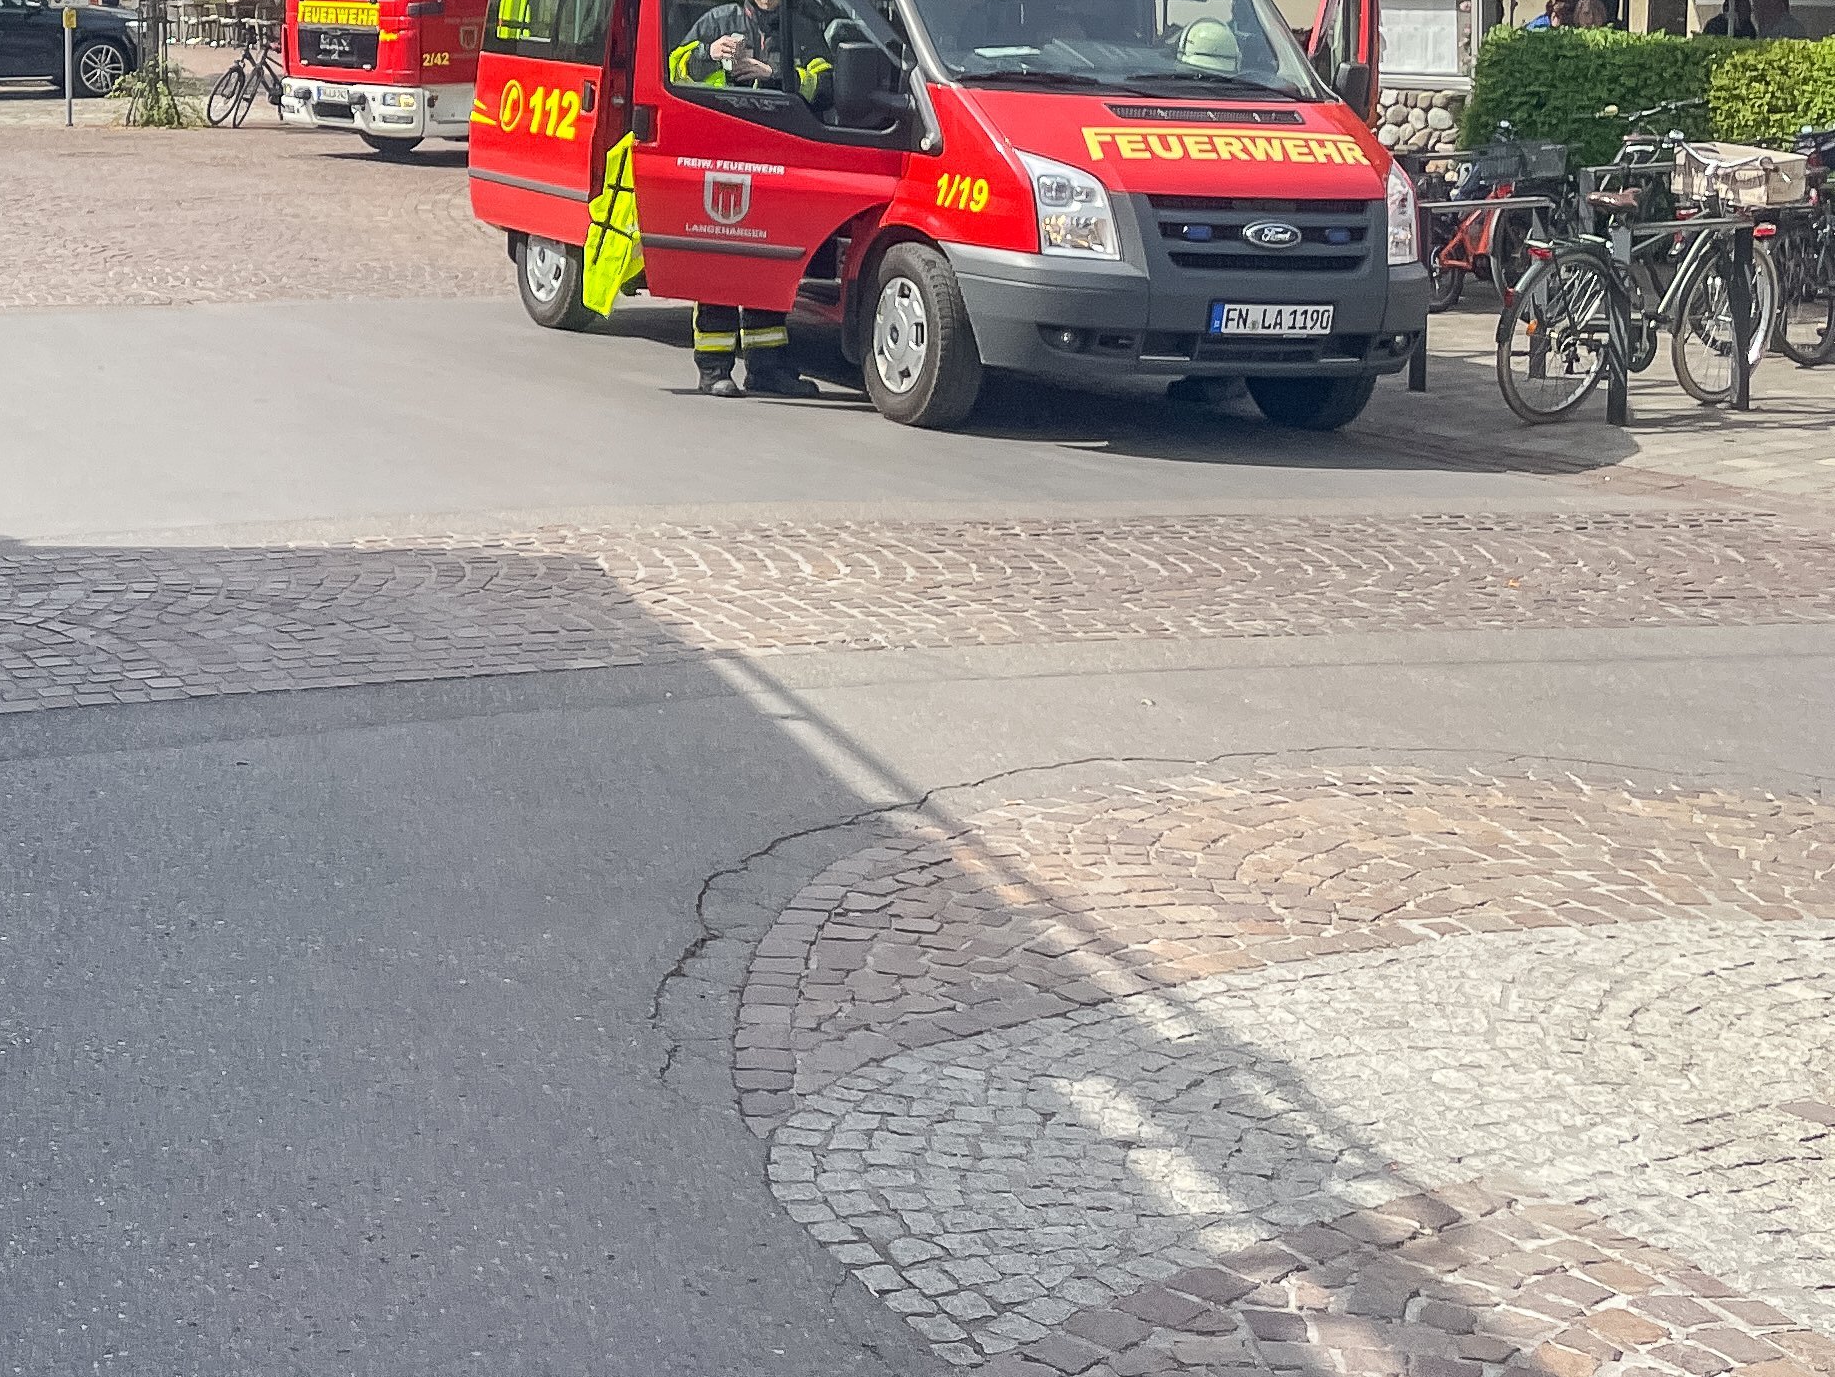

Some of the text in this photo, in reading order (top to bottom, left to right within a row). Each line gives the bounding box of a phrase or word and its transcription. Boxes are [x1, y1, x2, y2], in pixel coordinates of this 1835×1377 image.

[297, 0, 380, 26] FEUERWEHR
[422, 52, 450, 67] 2/42
[529, 86, 581, 140] 112
[1081, 127, 1371, 165] FEUERWEHR
[677, 156, 785, 175] FREIW. FEUERWEHR
[936, 173, 989, 212] 1/19
[1224, 308, 1330, 330] FN LA 1190
